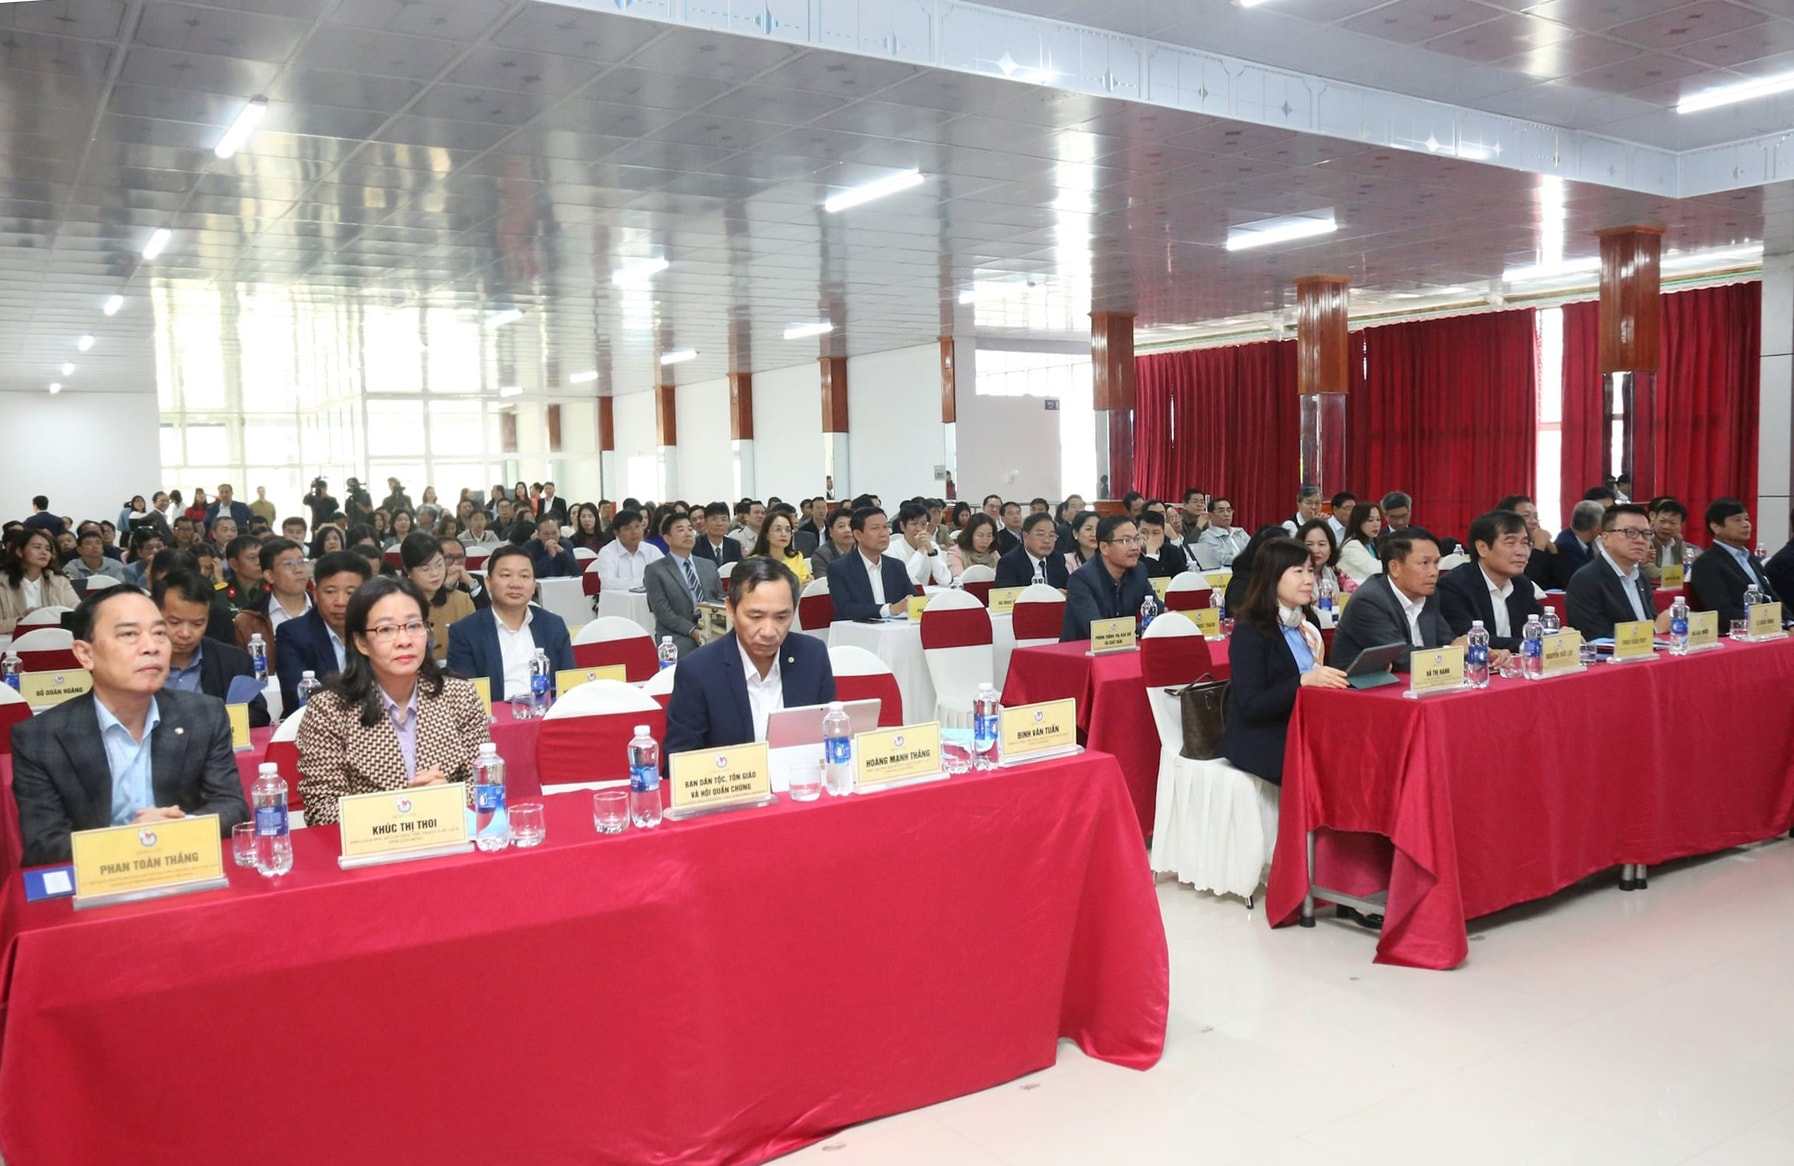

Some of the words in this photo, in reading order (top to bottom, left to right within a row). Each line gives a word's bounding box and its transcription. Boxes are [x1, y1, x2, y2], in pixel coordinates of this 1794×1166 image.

[865, 756, 888, 768] HOÀNG
[910, 749, 931, 760] THẮNG
[685, 780, 698, 788] BAN
[700, 776, 713, 785] DÂN
[729, 772, 741, 781] TÔN
[742, 770, 757, 779] GIÁO
[690, 790, 699, 799] VÀ
[372, 821, 397, 836] KHÚC
[400, 821, 414, 833] THỊ
[99, 861, 130, 875] PHAN
[133, 856, 161, 870] TOÀN
[164, 851, 199, 866] THẮNG
